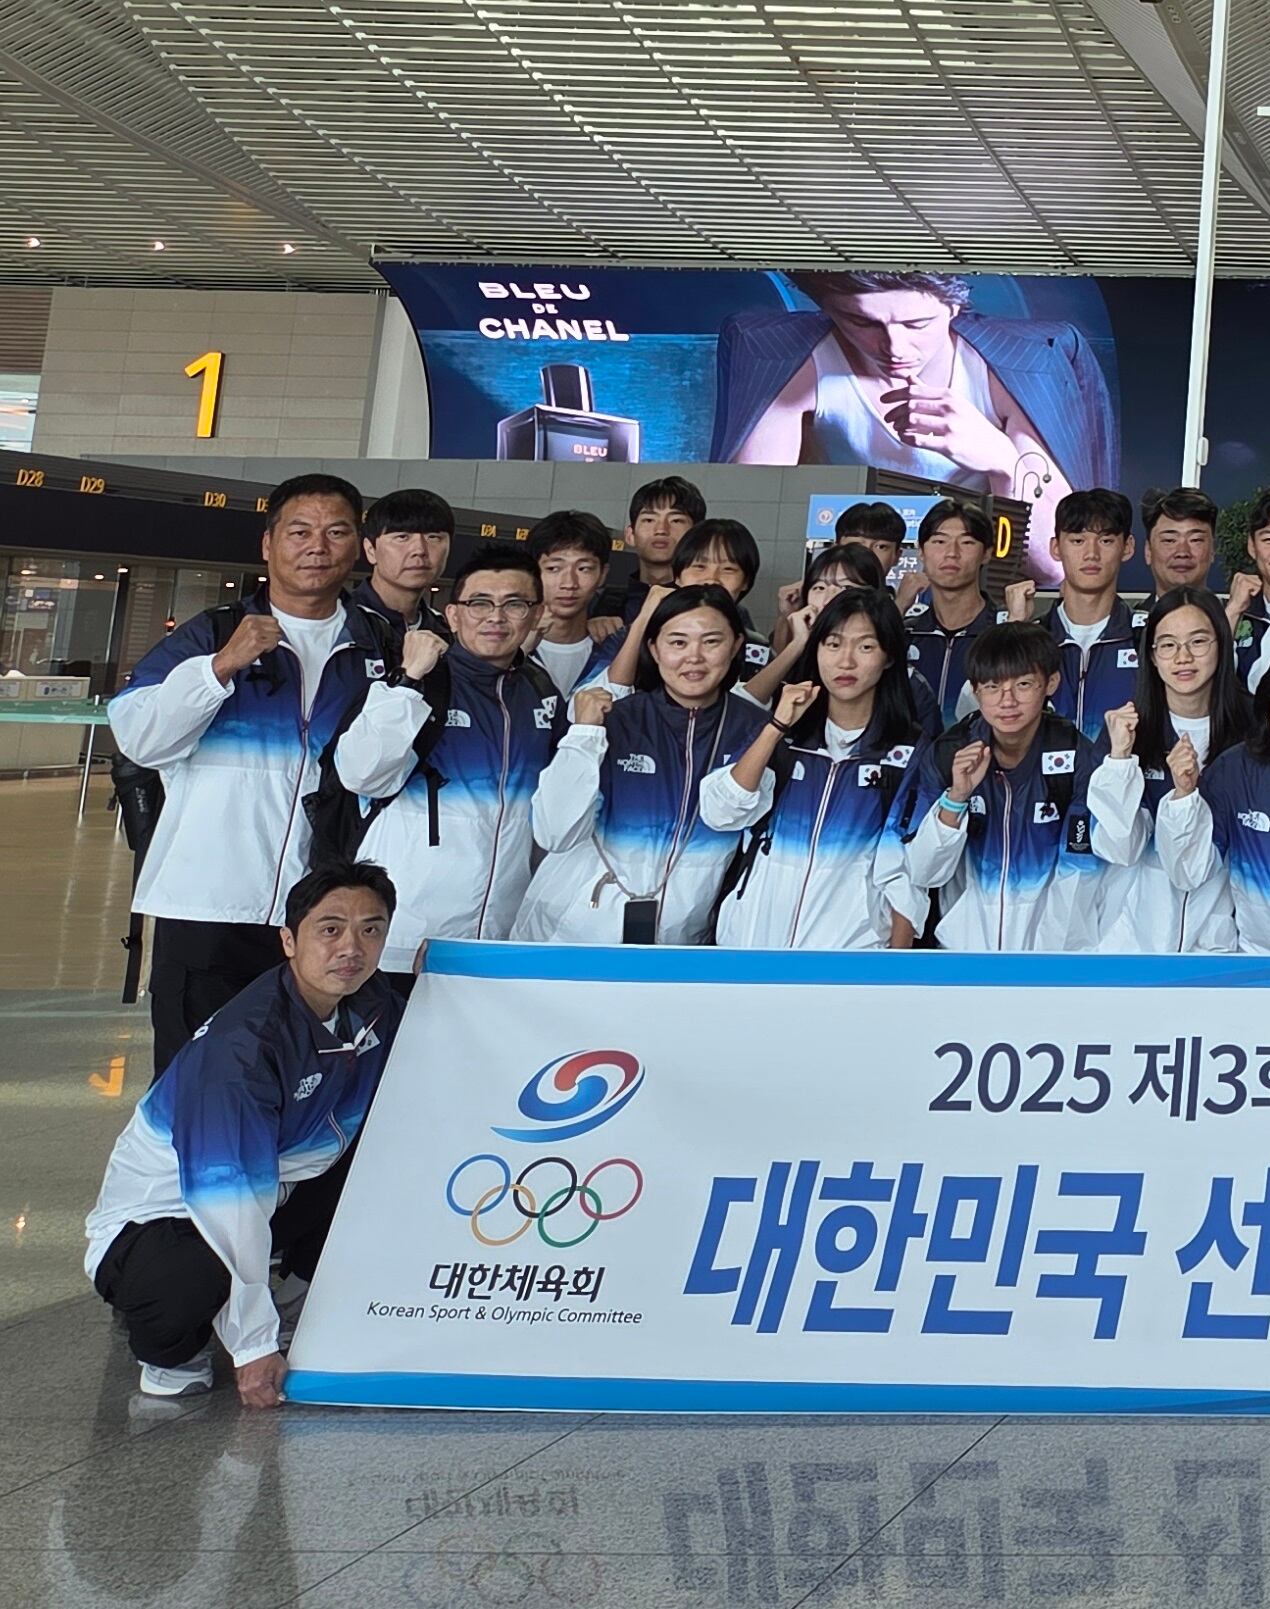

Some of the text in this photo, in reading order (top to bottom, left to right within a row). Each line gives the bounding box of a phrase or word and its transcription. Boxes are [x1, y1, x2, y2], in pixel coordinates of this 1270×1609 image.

[479, 282, 591, 300] BLEU
[532, 303, 559, 314] DE
[479, 317, 630, 342] CHANEL
[184, 351, 223, 438] 1
[573, 443, 608, 457] BLEU
[16, 469, 45, 488] D28
[80, 476, 105, 494] D29
[204, 492, 226, 508] D30
[996, 516, 1011, 558] D
[928, 1042, 1111, 1113] 2025
[683, 1160, 1147, 1339] 대한민국
[429, 1263, 604, 1303] 대한체육회
[366, 1302, 642, 1325] Korean Sport & Olympic Committee
